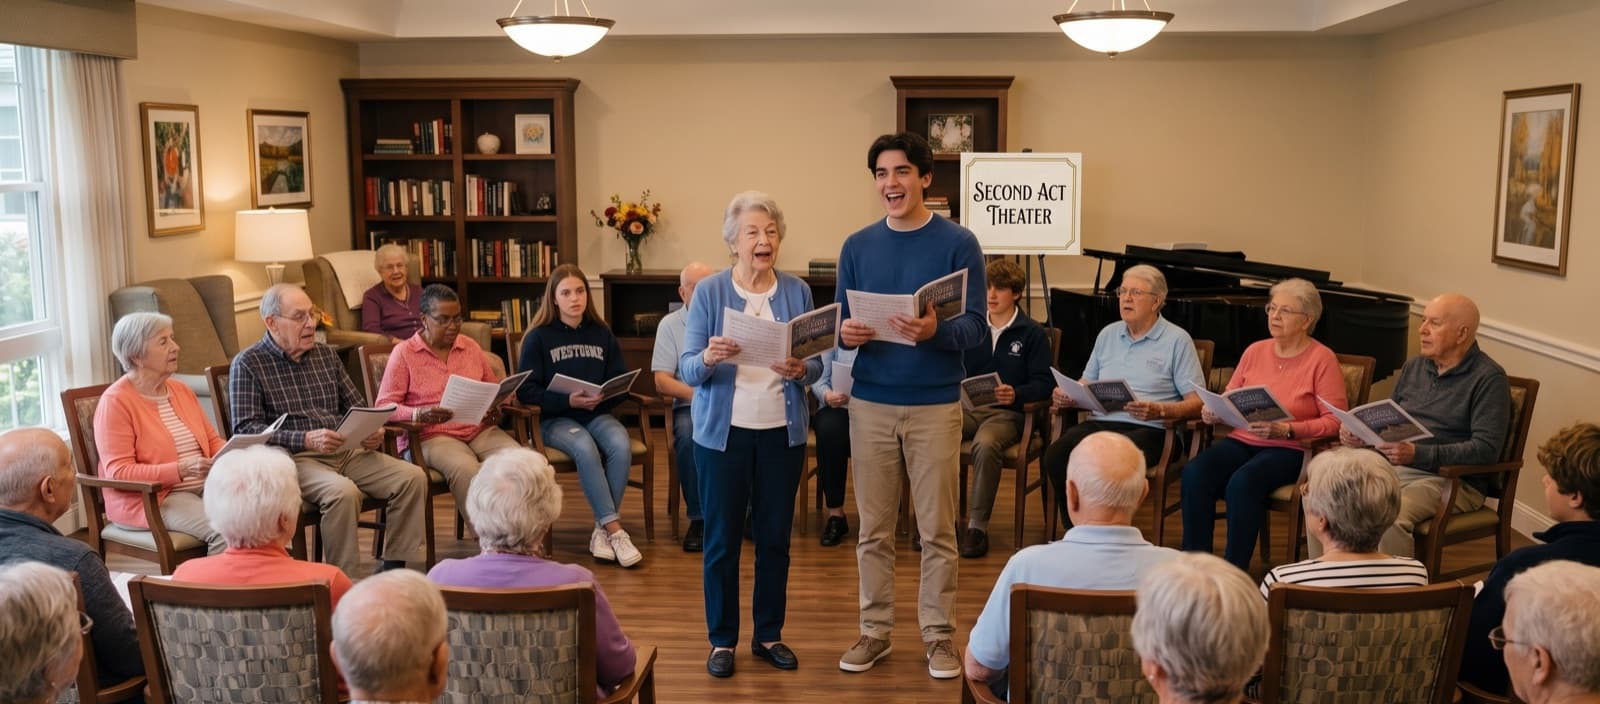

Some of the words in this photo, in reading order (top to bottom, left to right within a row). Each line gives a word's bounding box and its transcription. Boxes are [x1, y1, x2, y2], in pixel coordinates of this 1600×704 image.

[973, 181, 1032, 202] SECOND
[1037, 182, 1067, 201] ACT
[986, 204, 1052, 225] THEATER
